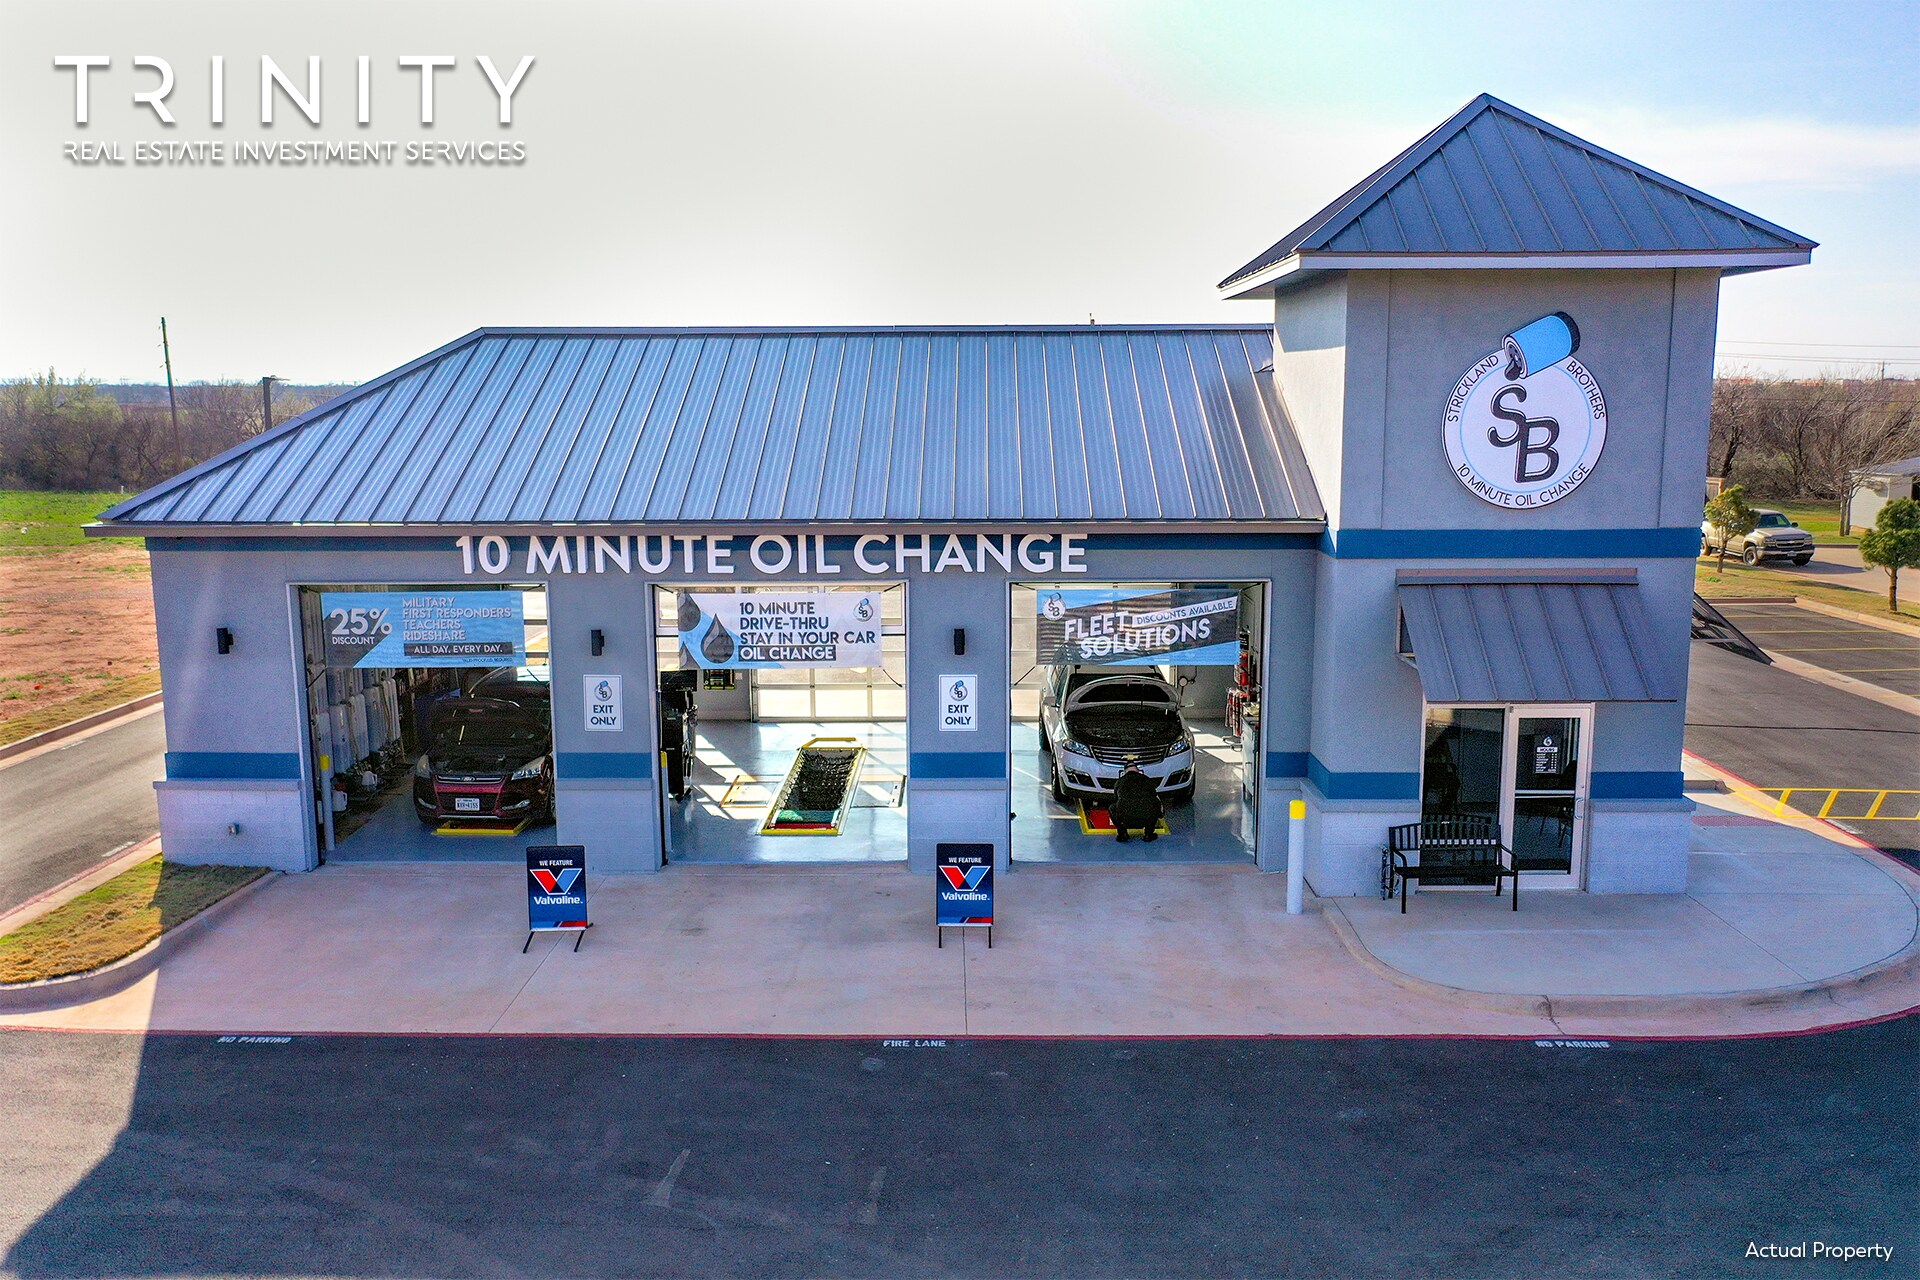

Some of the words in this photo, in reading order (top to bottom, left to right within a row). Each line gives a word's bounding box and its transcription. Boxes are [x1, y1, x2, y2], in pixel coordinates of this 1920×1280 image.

[1447, 354, 1499, 423] STRICKLAND
[1566, 360, 1605, 420] BROTHERS
[1456, 463, 1470, 478] 10
[1467, 474, 1513, 506] MINUTE
[1515, 494, 1537, 506] OIL
[1539, 463, 1591, 503] CHANGE
[456, 535, 511, 575] 10
[526, 535, 736, 575] MINUTE
[749, 534, 841, 575] OIL
[853, 534, 1089, 574] CHANGE
[403, 597, 455, 608] MILITARY
[739, 602, 755, 615] 10
[758, 601, 815, 615] MINUTE
[403, 608, 434, 619] FIRST
[436, 608, 512, 618] RESPONDERS
[1136, 609, 1187, 625] DISCOUNTS
[1189, 600, 1234, 616] AVAILABLE
[330, 608, 393, 635] 25%
[403, 620, 461, 630] TEACHERS
[740, 617, 829, 630] DRIVE-THRU
[1064, 611, 1129, 641] FLEET
[332, 637, 375, 645] DISCOUNT
[403, 630, 466, 641] RIDESHARE
[740, 632, 773, 645] STAY
[778, 632, 794, 645] IN
[798, 631, 839, 645] YOUR
[844, 631, 876, 644] CAR
[1080, 618, 1211, 660] SOLUTIONS
[414, 645, 431, 654] ALL
[432, 645, 451, 654] DAY.
[453, 645, 481, 653] EVERY
[484, 644, 503, 653] DAY.
[740, 647, 764, 660] OIL
[768, 647, 834, 660] CHANGE
[593, 704, 614, 714] EXIT
[948, 704, 969, 714] EXIT
[590, 716, 616, 725] ONLY
[945, 716, 971, 725] ONLY
[1554, 1040, 1610, 1048] PARKING
